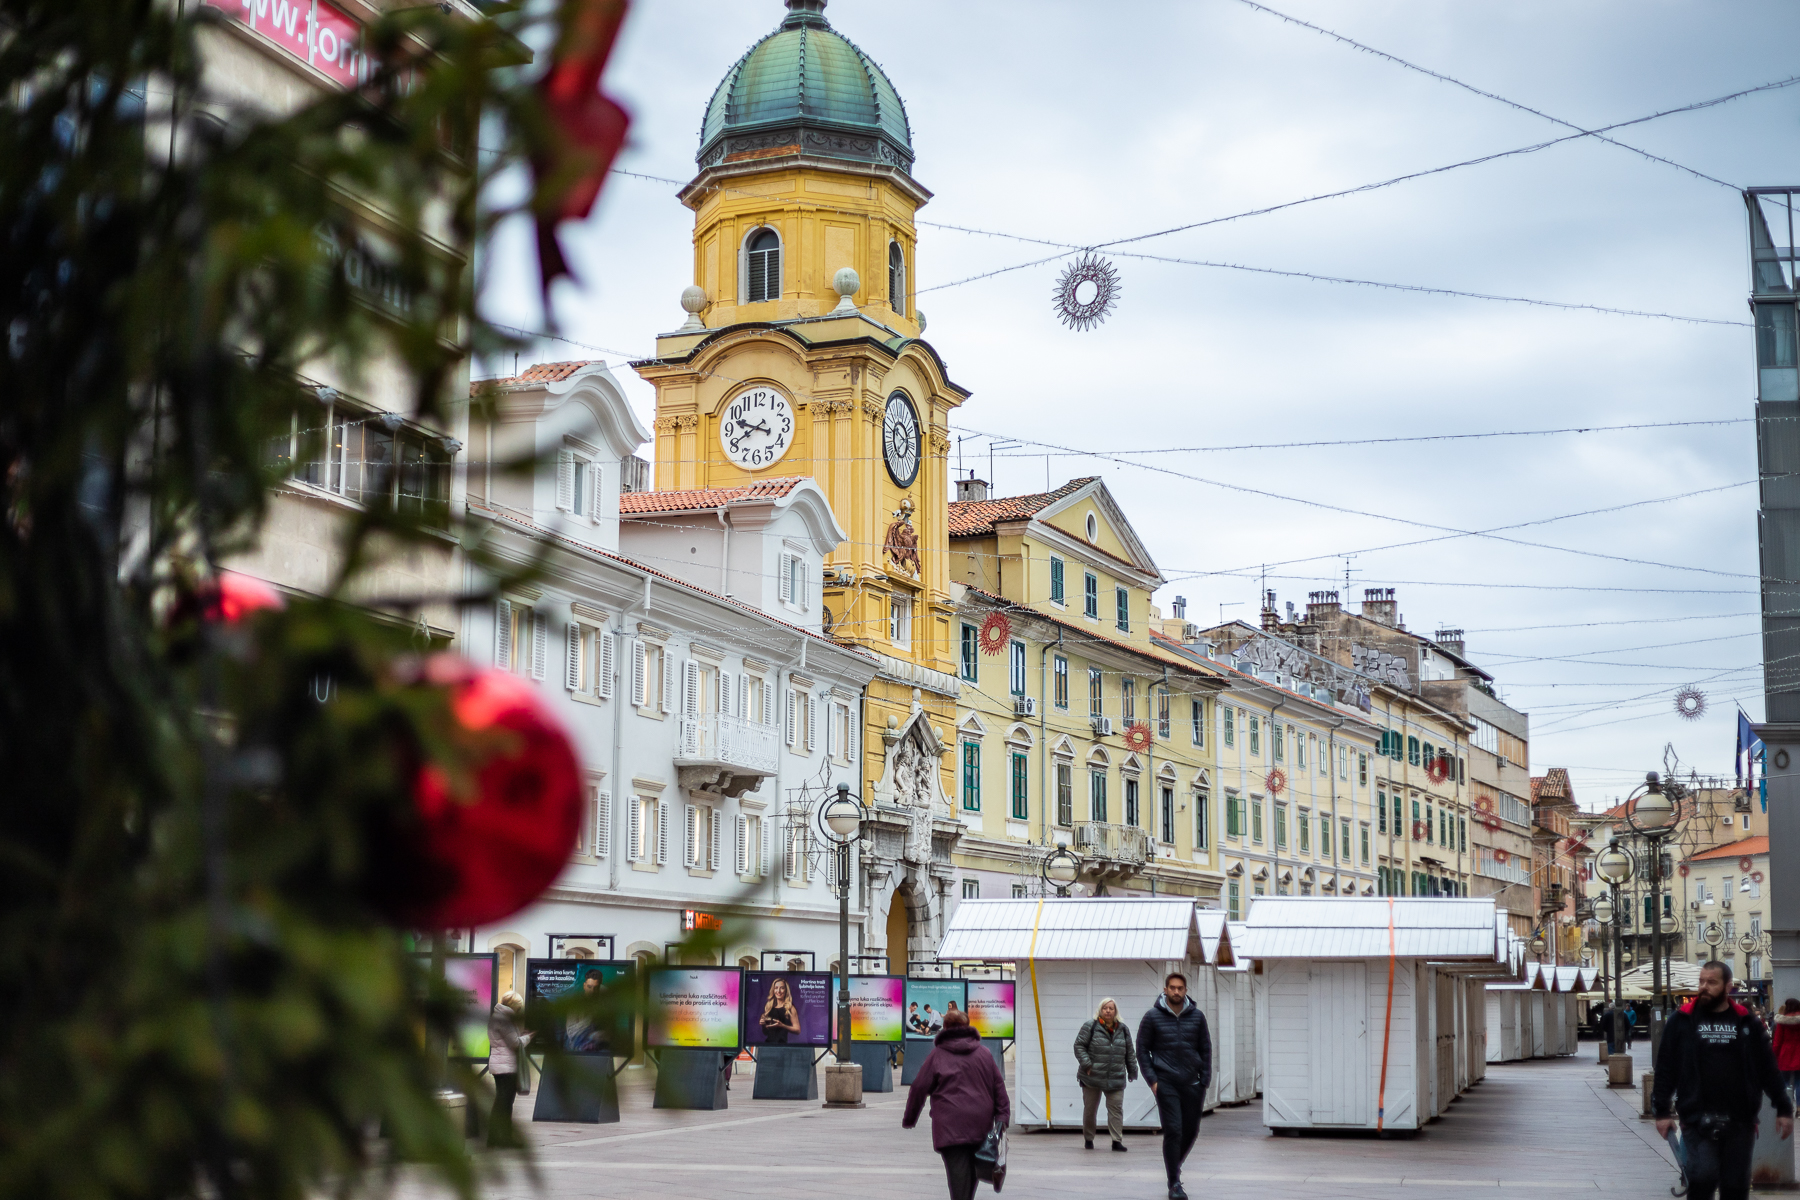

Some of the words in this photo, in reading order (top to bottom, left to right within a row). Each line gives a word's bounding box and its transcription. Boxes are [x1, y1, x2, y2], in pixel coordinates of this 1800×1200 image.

[742, 396, 751, 411] 11
[754, 392, 765, 407] 12
[770, 395, 775, 410] 1
[730, 405, 742, 419] 10
[776, 402, 785, 417] 2
[724, 422, 734, 437] 9
[781, 417, 791, 433] 3
[730, 438, 739, 453] 8
[774, 433, 784, 448] 4
[742, 448, 750, 462] 7
[752, 450, 762, 464] 6
[764, 445, 774, 460] 5
